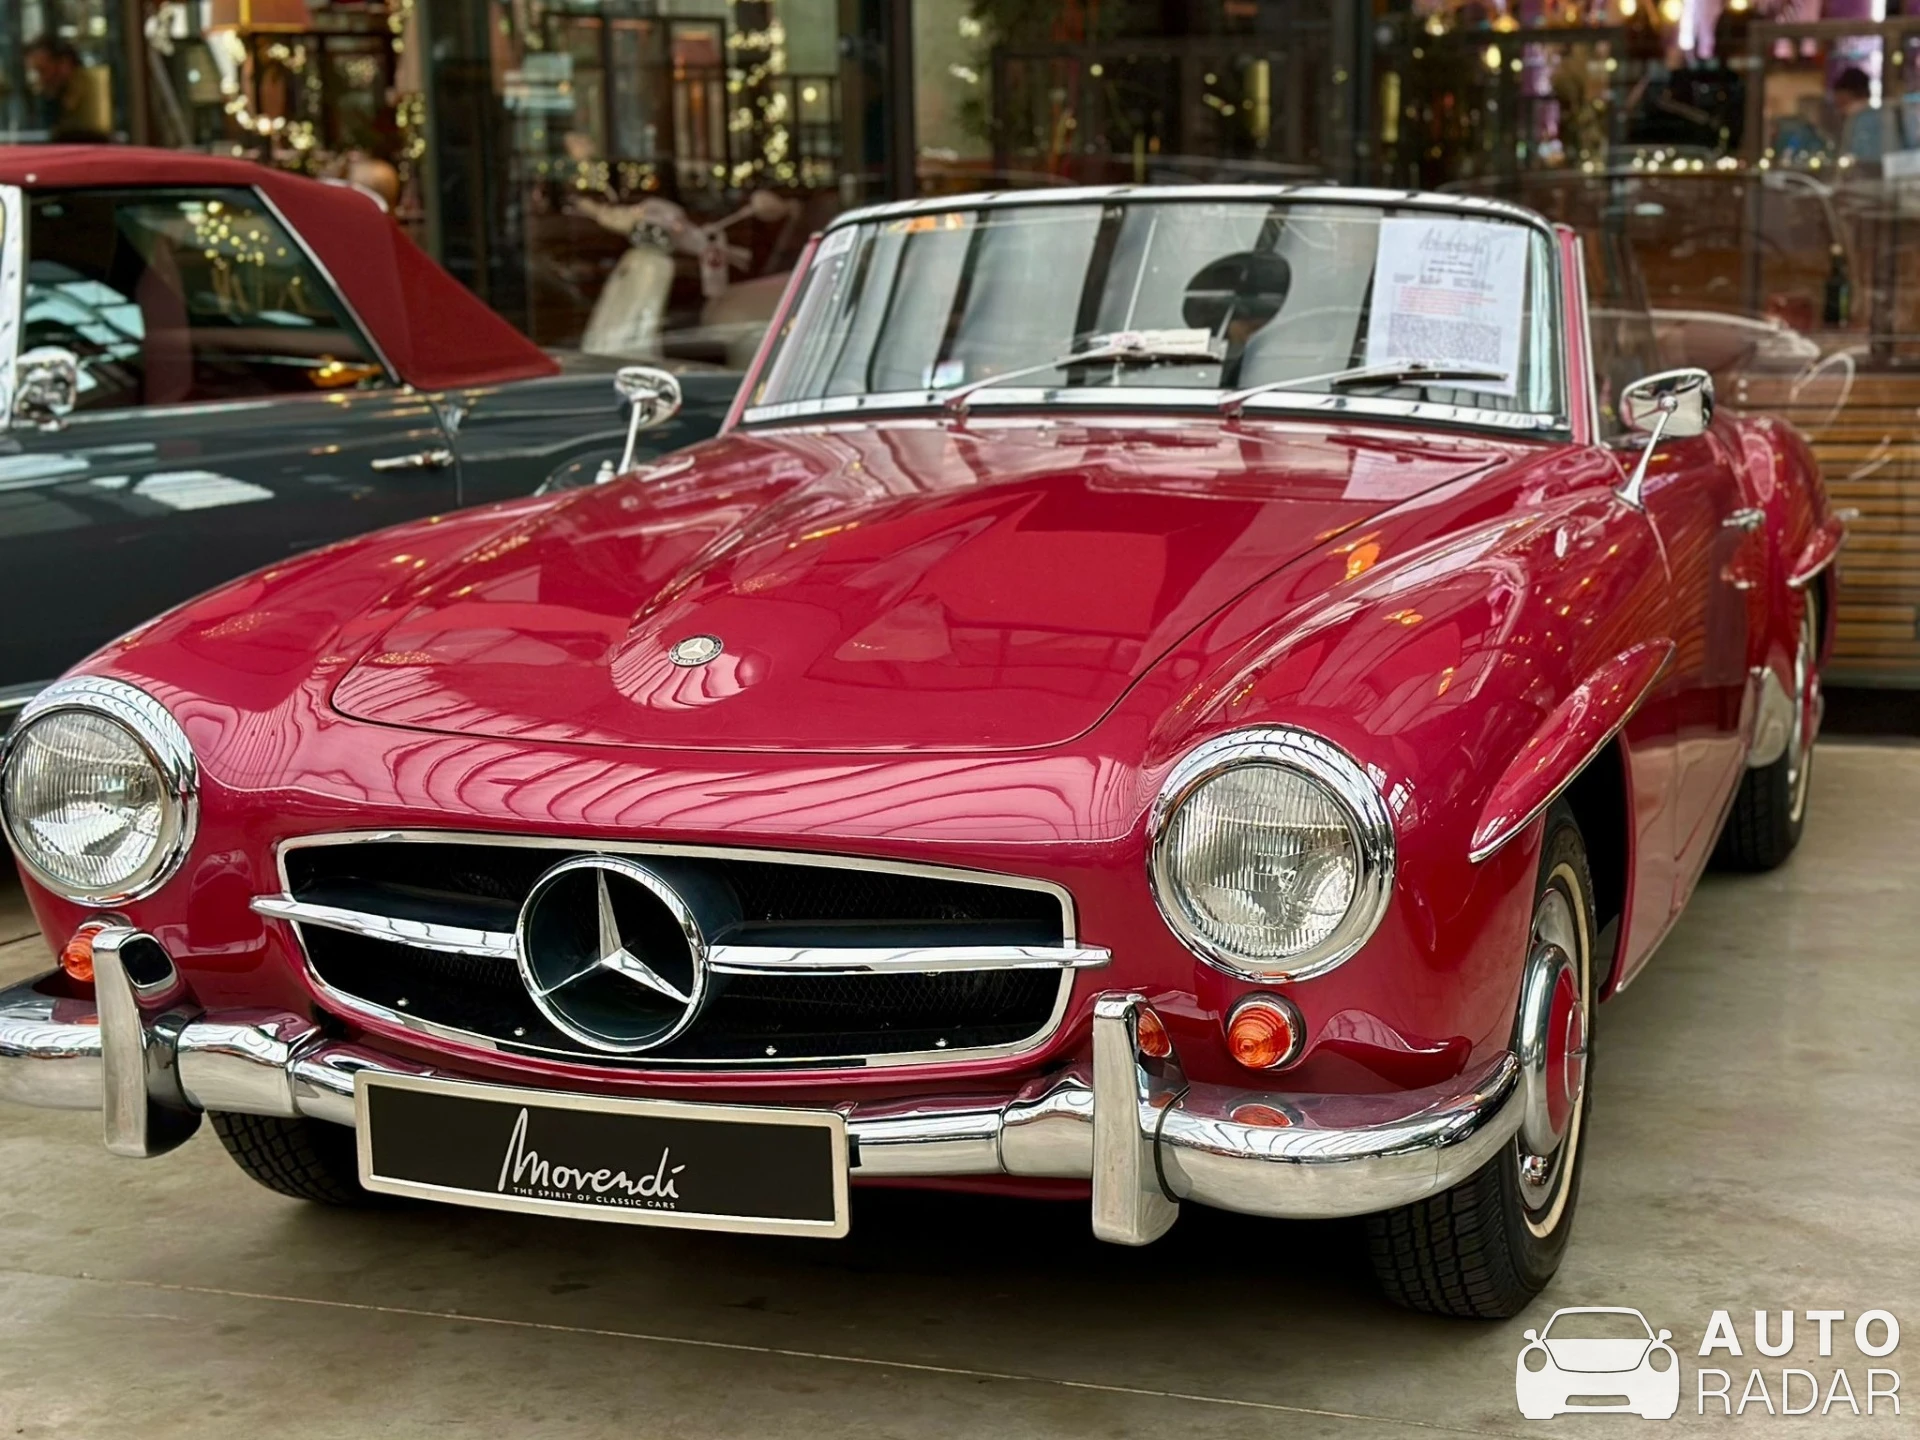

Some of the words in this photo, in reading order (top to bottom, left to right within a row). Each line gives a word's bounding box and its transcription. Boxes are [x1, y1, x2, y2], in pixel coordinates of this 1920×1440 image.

[513, 1186, 533, 1196] THE
[538, 1189, 572, 1200] SPIRIT
[577, 1193, 591, 1202] OF
[595, 1195, 642, 1207] CLASSIC
[647, 1200, 676, 1209] CARS
